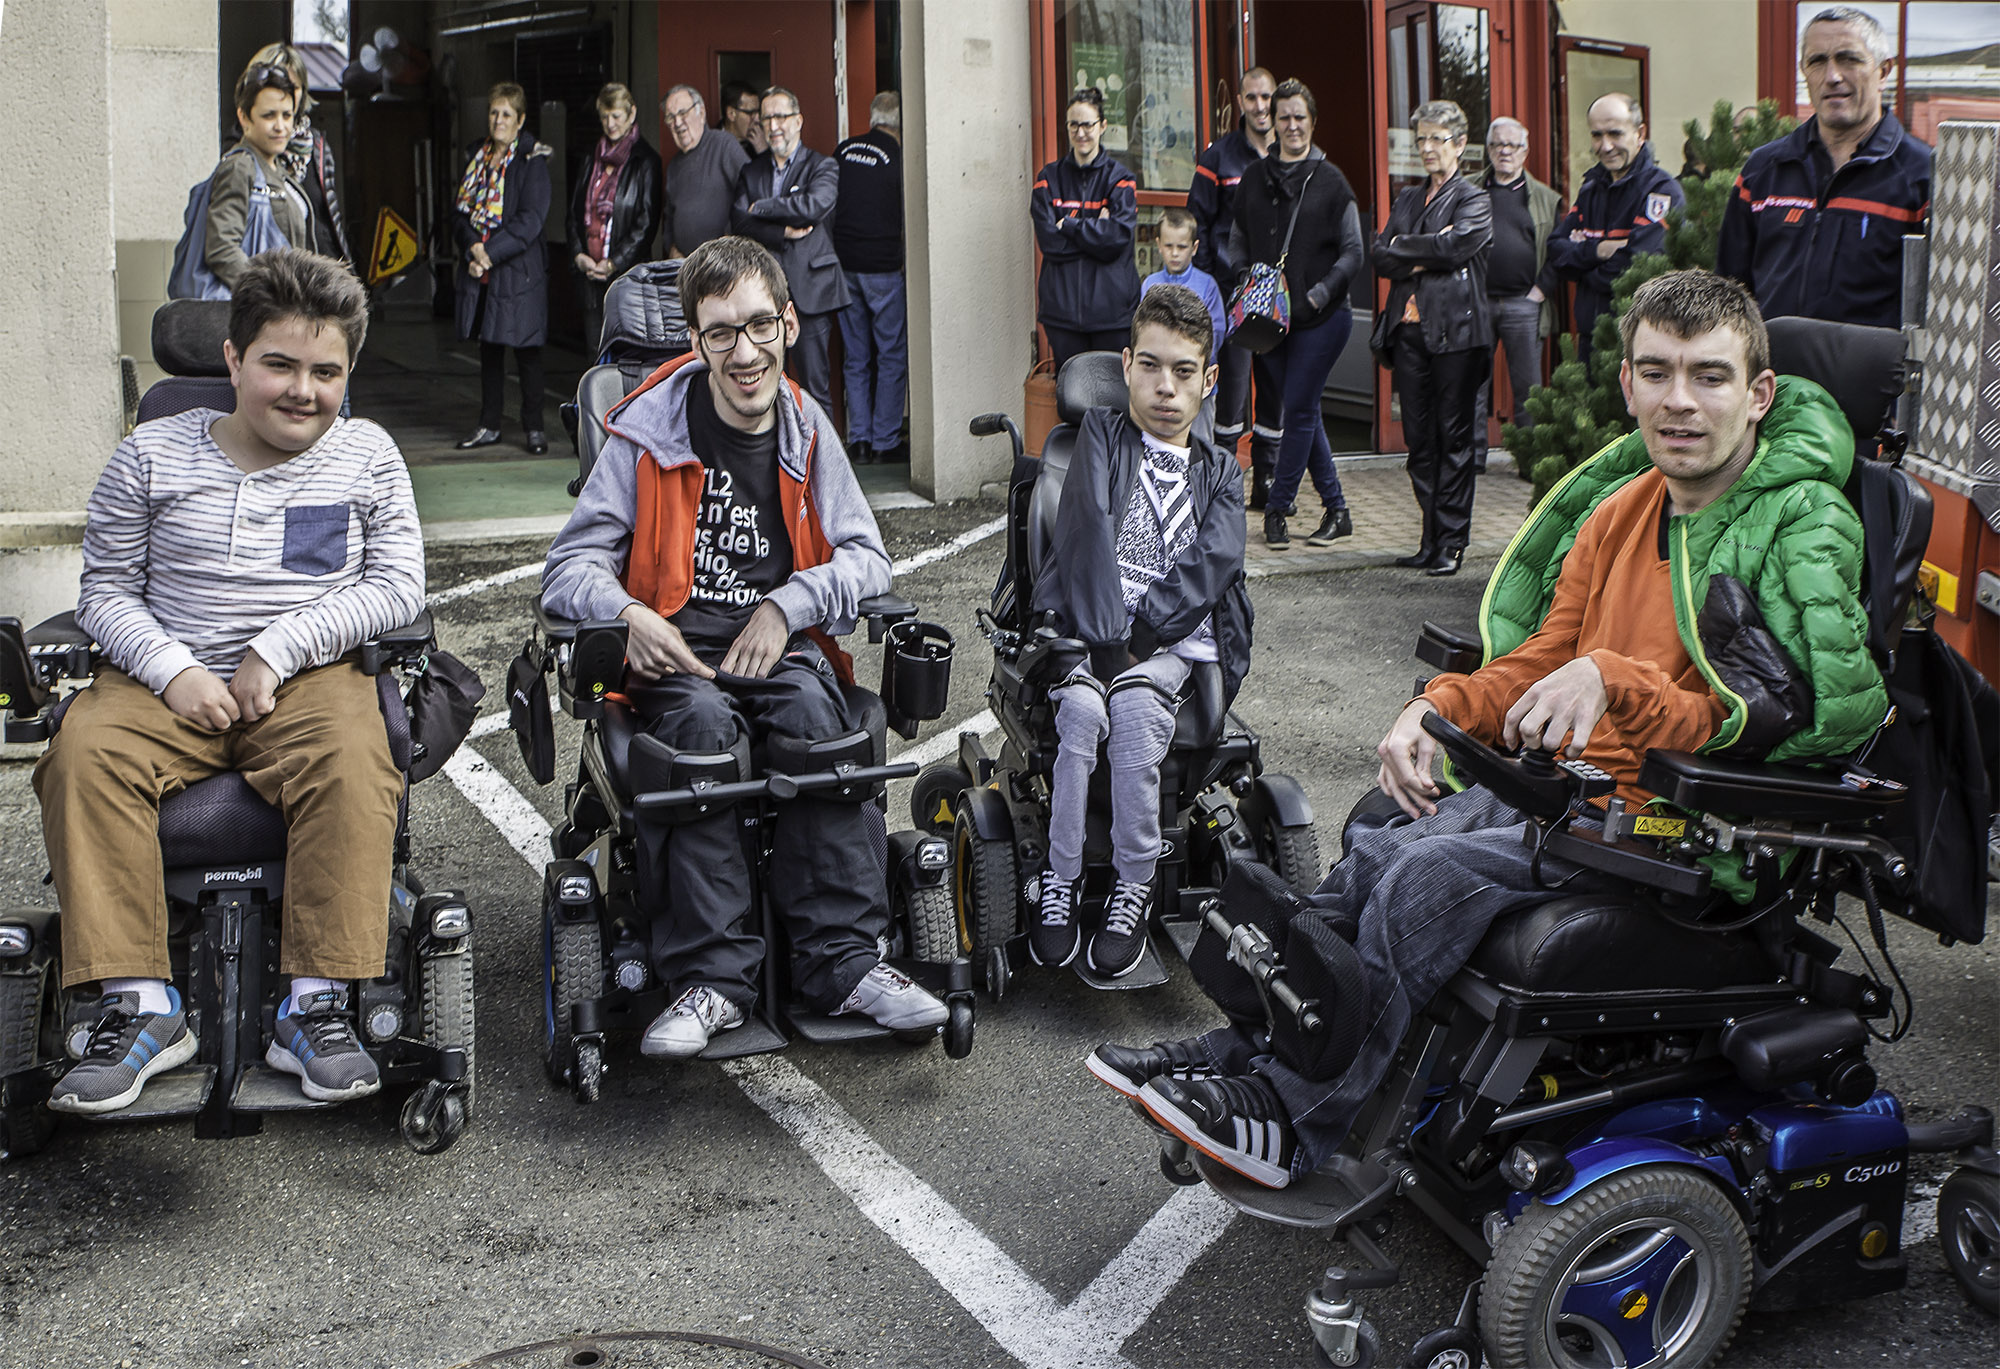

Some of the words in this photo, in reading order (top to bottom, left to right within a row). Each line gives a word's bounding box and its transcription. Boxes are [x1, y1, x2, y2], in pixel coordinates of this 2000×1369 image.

[707, 497, 759, 529] n'est
[718, 525, 750, 554] de
[753, 529, 770, 558] la
[204, 867, 263, 884] permobil
[1844, 1161, 1901, 1182] C500
